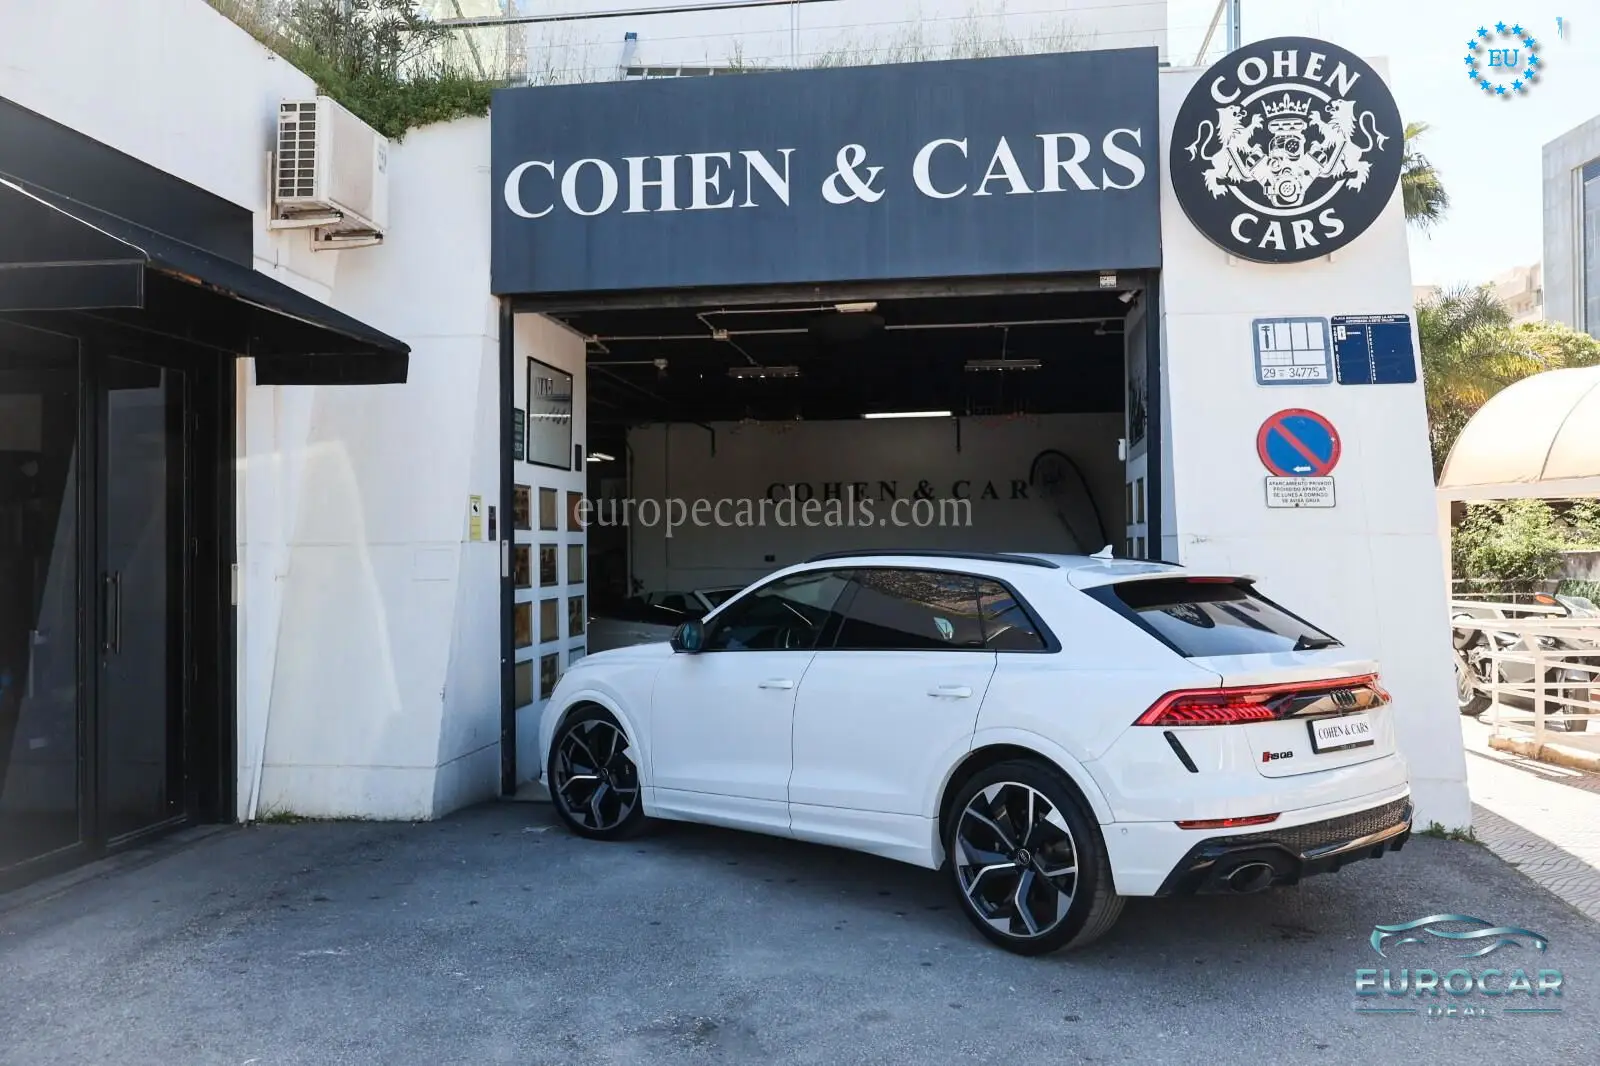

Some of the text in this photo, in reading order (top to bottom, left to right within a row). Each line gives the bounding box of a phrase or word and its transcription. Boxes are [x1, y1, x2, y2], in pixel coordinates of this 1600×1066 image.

[1210, 50, 1361, 104] COHEN
[504, 127, 1146, 219] COHEN & CARS
[1230, 208, 1345, 250] CARS
[1263, 367, 1276, 379] 29
[1289, 366, 1320, 378] 34775
[766, 479, 897, 504] COHEN
[913, 479, 936, 500] &
[1318, 722, 1369, 740] COHEN & CARS
